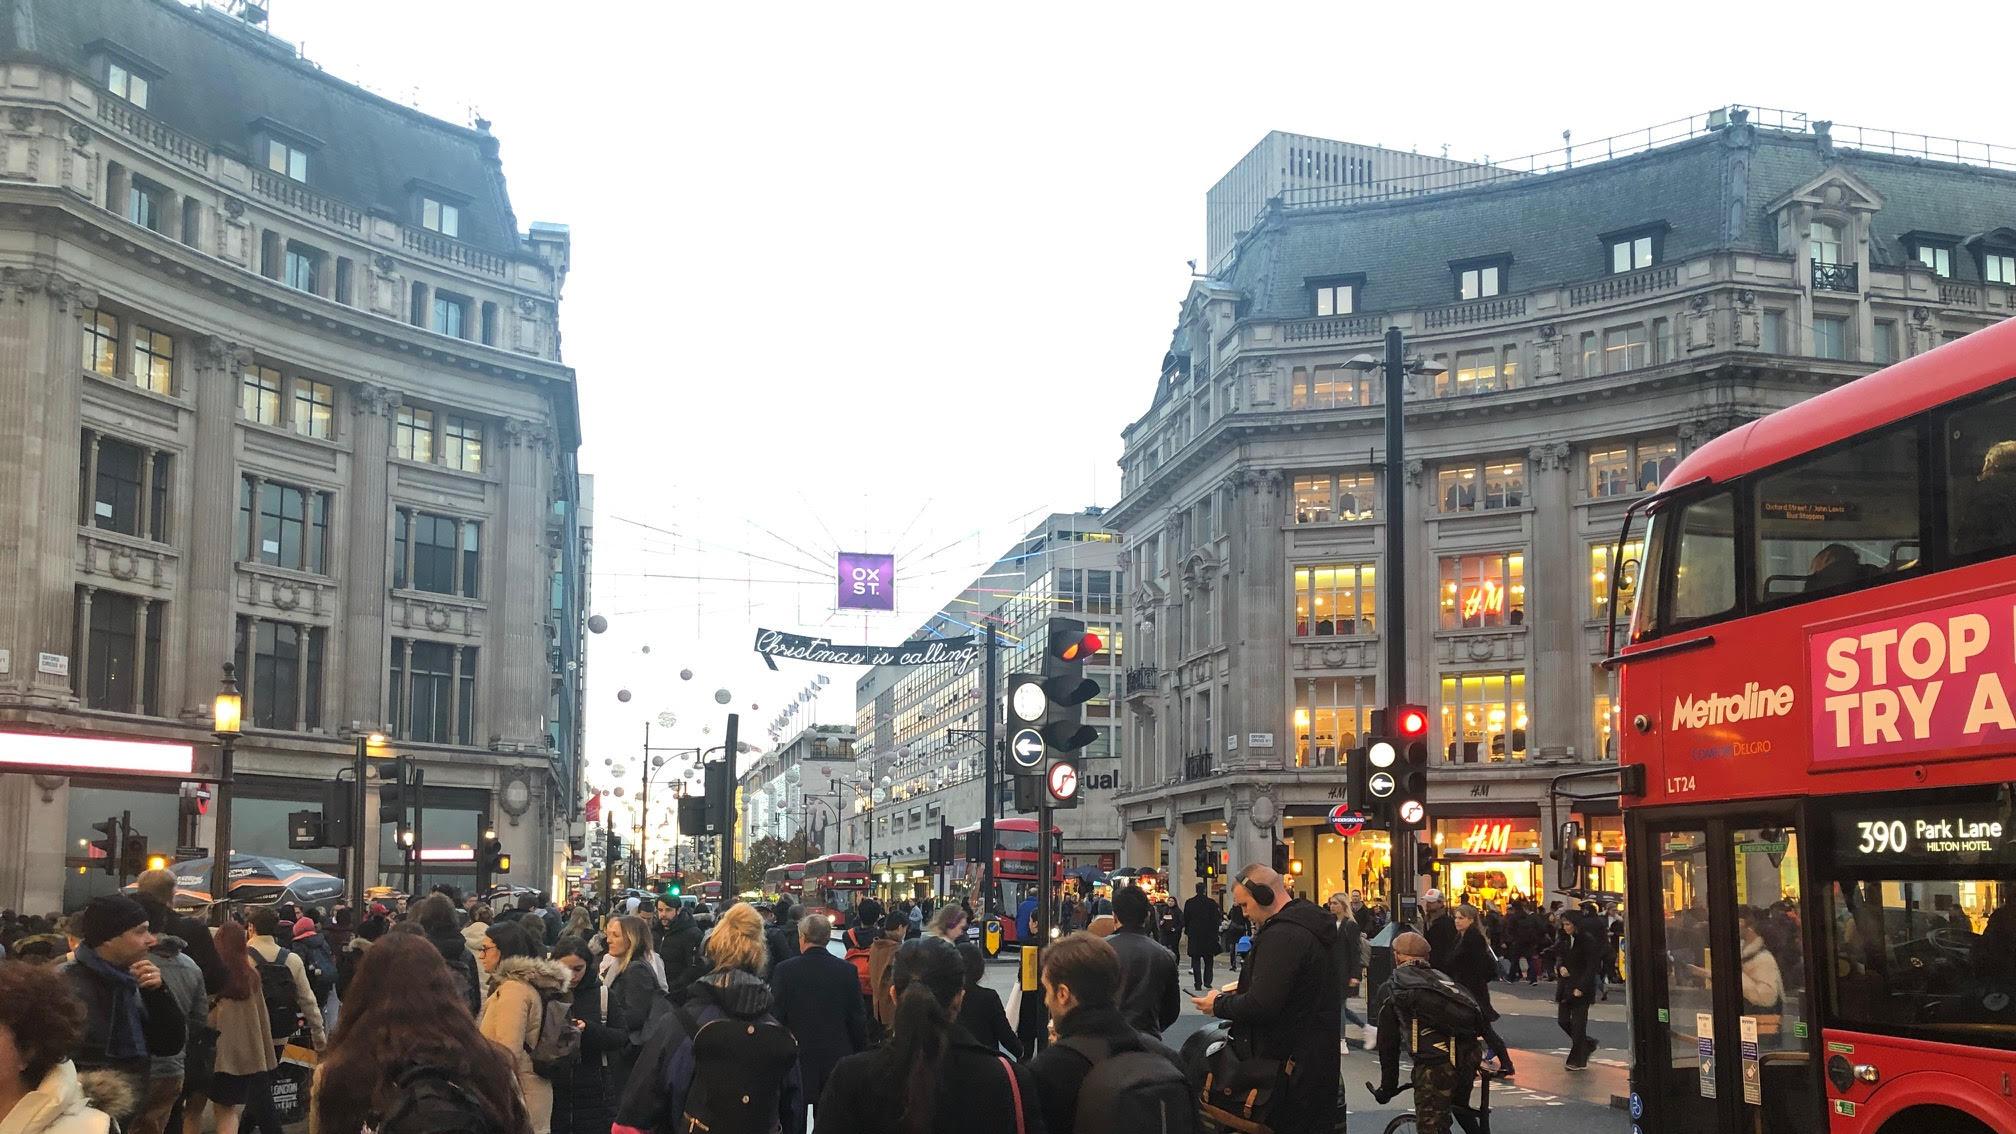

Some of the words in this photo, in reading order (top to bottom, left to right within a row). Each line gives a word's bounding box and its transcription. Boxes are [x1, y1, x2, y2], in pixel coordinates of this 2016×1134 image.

[852, 567, 880, 582] OX
[853, 581, 880, 595] ST.
[1464, 585, 1504, 620] H&M
[757, 630, 866, 664] Christmas
[873, 646, 895, 664] is
[900, 642, 979, 675] calling
[1825, 613, 1991, 692] STOP
[1671, 681, 1795, 731] Metroline
[1825, 680, 1943, 748] TRY
[1328, 787, 1347, 799] H&M
[1470, 784, 1490, 797] H&M
[1667, 776, 1696, 793] LT24
[1466, 824, 1511, 854] H&M
[1857, 820, 1908, 853] 390
[1916, 819, 1953, 839] Park
[1958, 818, 2003, 838] Lane
[1926, 842, 1960, 852] HILTON
[1961, 841, 1993, 851] HOTEL
[271, 1083, 298, 1096] LONDON
